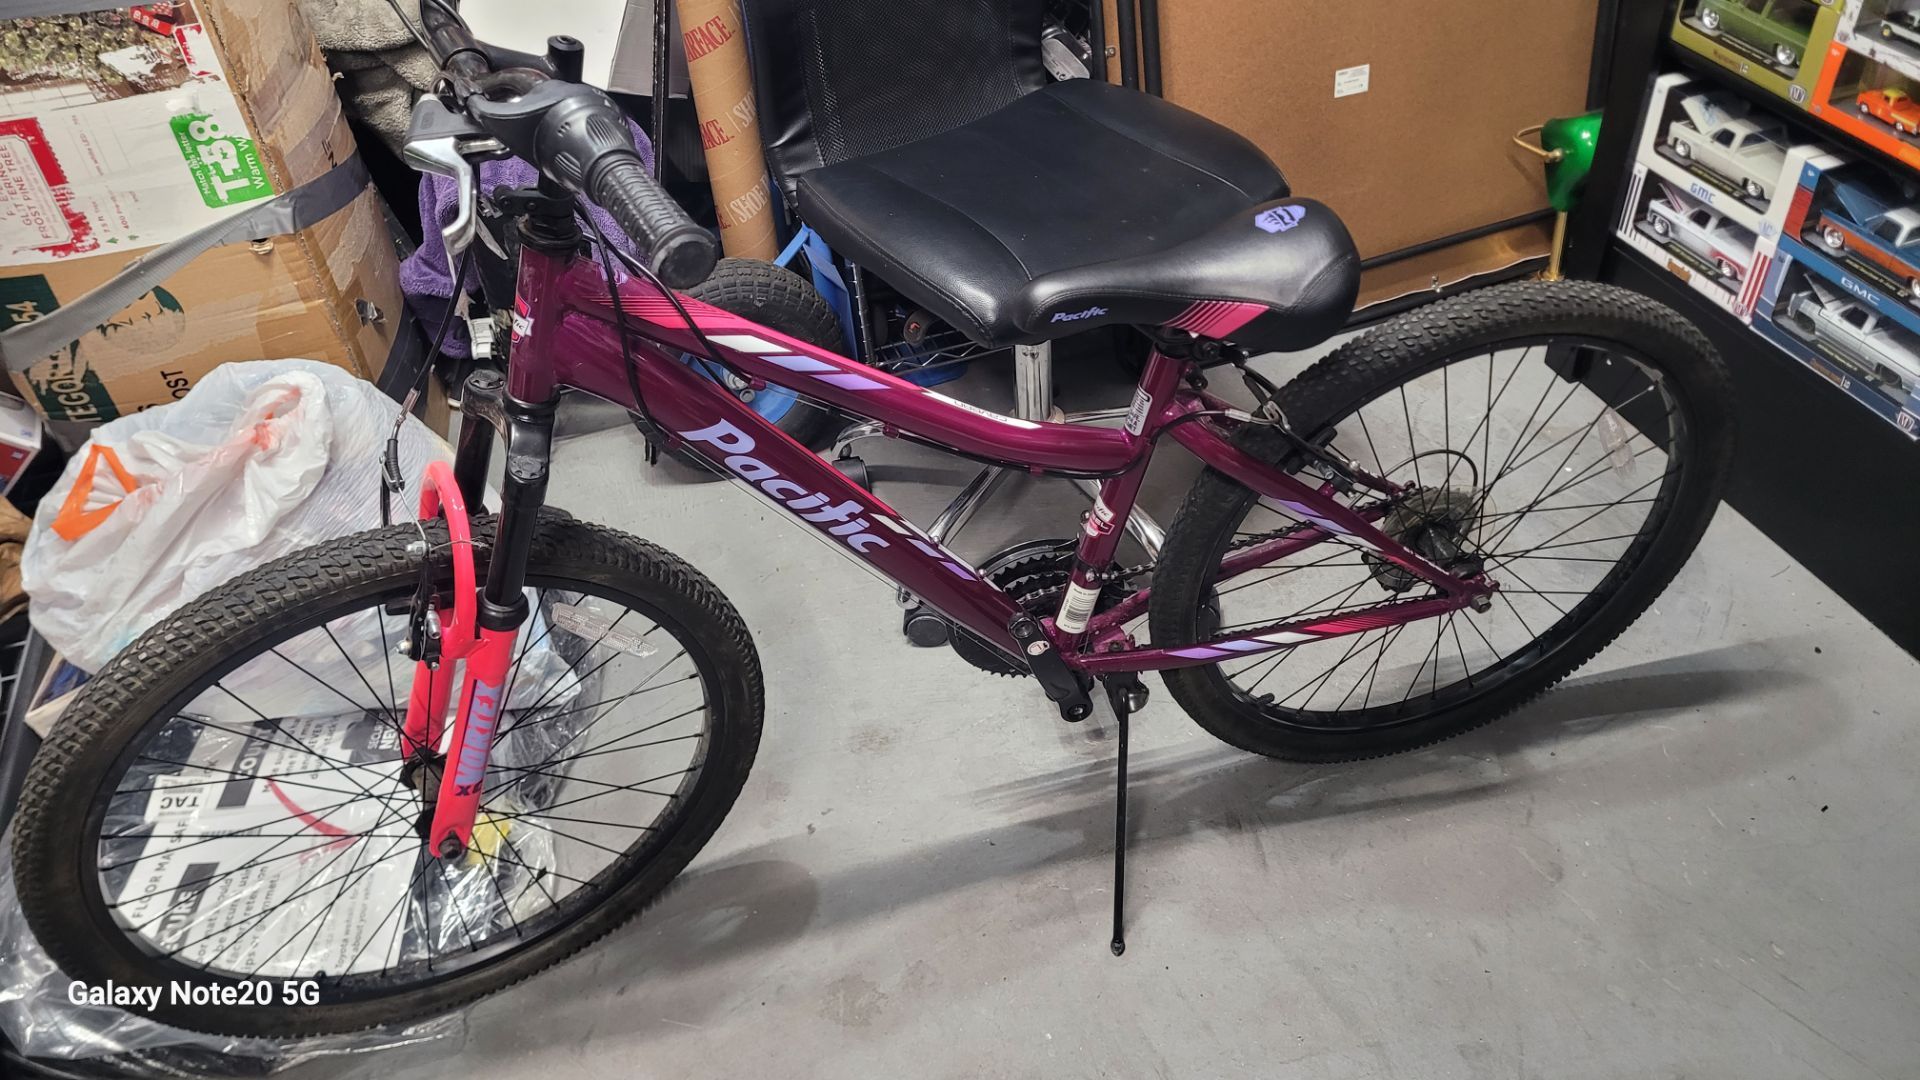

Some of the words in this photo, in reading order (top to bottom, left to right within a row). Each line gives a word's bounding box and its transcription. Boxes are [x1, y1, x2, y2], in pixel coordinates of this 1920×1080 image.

[0, 143, 17, 173] TREE
[244, 153, 265, 190] Warm
[12, 174, 32, 202] PINE
[1690, 183, 1716, 204] GMC
[1841, 277, 1880, 306] GMC
[1050, 306, 1109, 323] Pacific
[676, 418, 891, 553] Pacific
[455, 680, 504, 786] VORTEX
[160, 796, 200, 810] TAC
